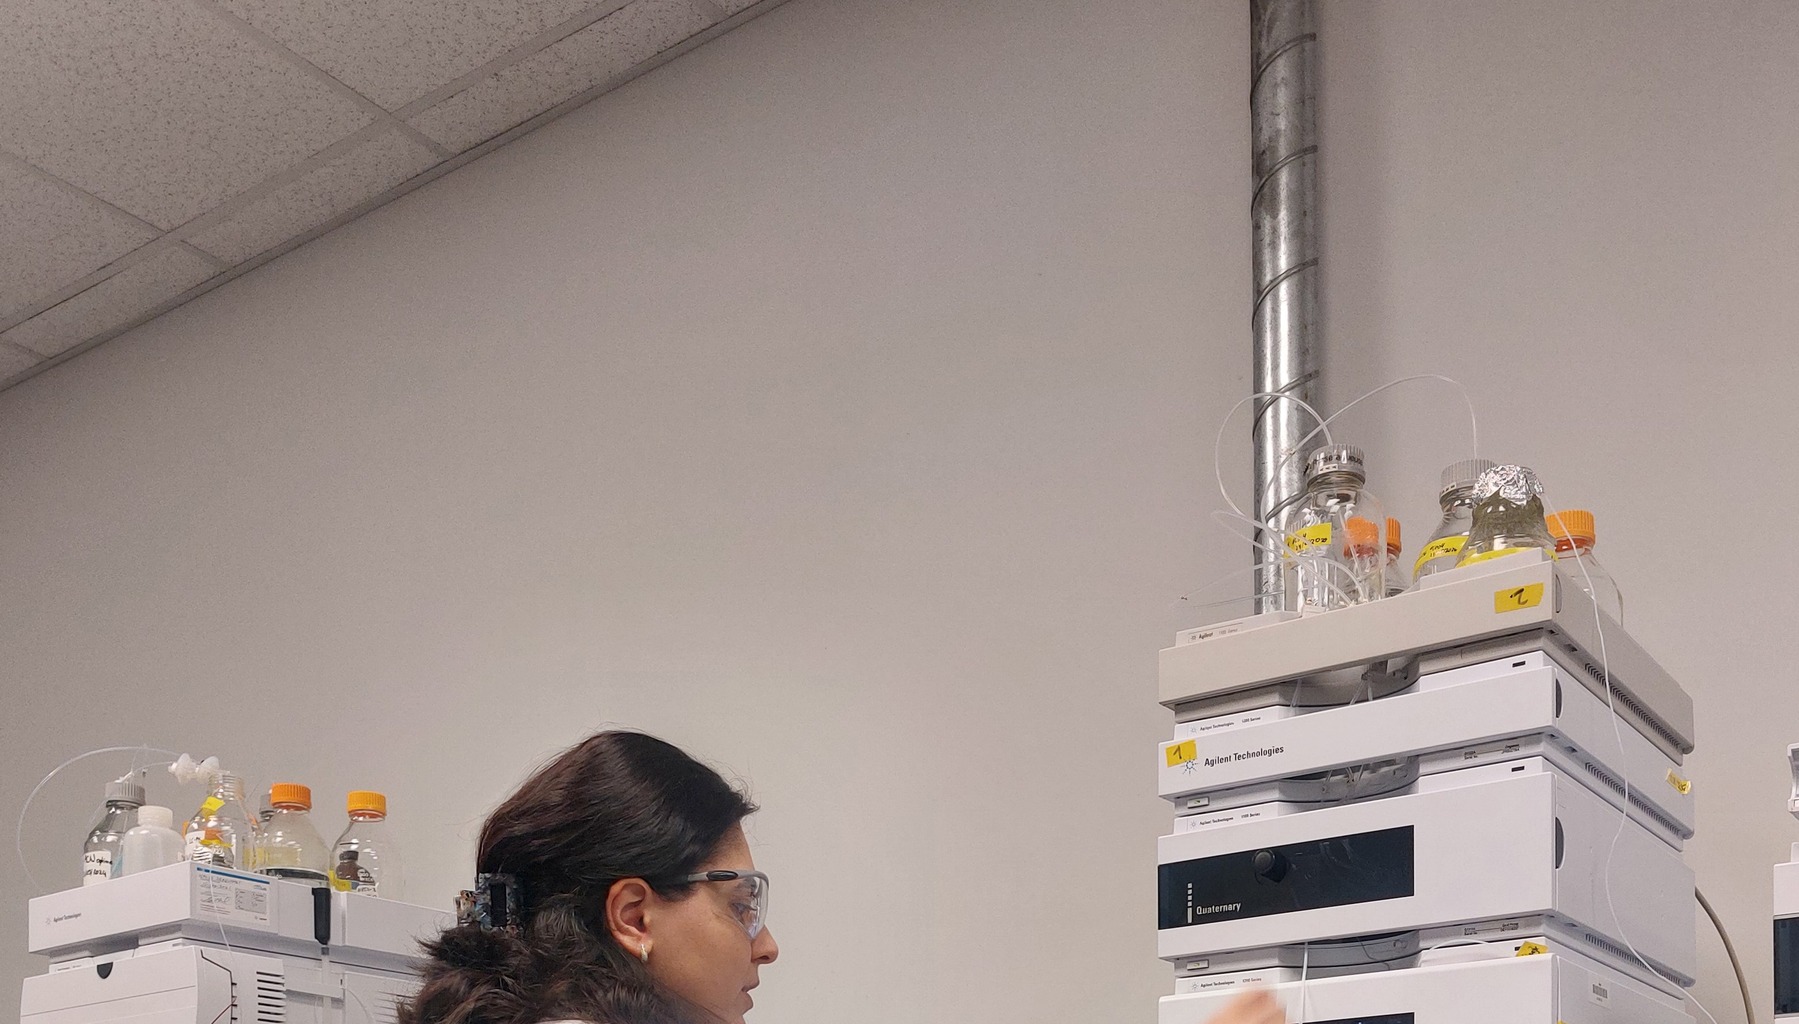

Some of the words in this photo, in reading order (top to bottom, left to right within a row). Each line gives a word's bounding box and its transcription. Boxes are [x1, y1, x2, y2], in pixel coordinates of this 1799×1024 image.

[1198, 632, 1214, 640] Agilent
[1204, 755, 1232, 768] Agilent
[1233, 746, 1285, 762] Technologies
[1196, 902, 1242, 915] Quaternary
